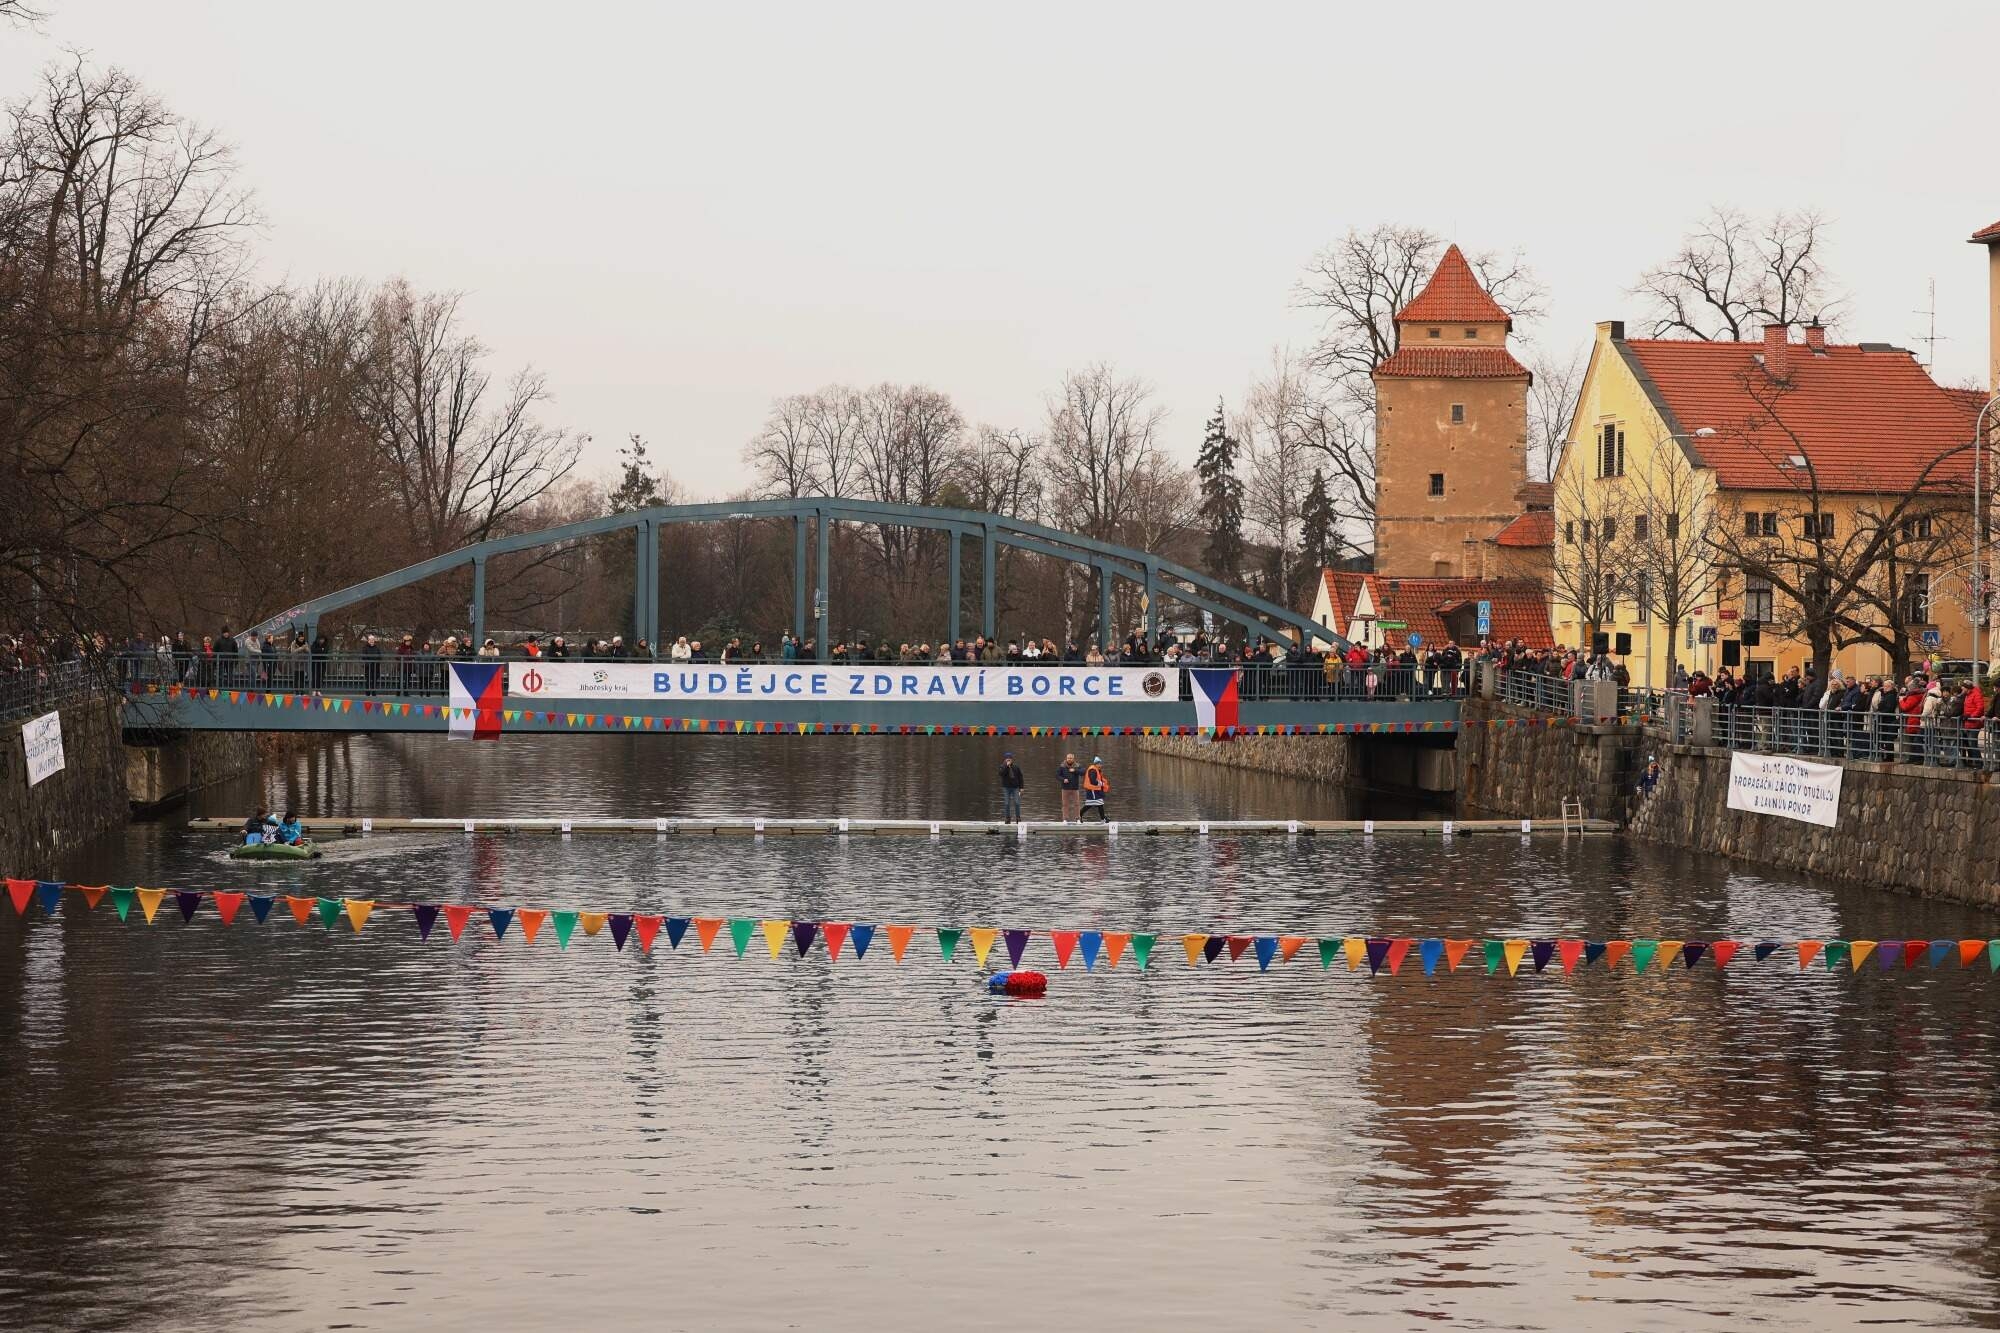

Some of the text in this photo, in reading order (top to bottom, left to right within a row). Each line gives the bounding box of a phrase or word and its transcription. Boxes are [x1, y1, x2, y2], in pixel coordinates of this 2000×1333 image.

[614, 684, 628, 693] kraj
[653, 666, 829, 695] BUDĚJCE
[848, 668, 986, 696] ZDRAVÍ
[1007, 673, 1124, 697] BORCE
